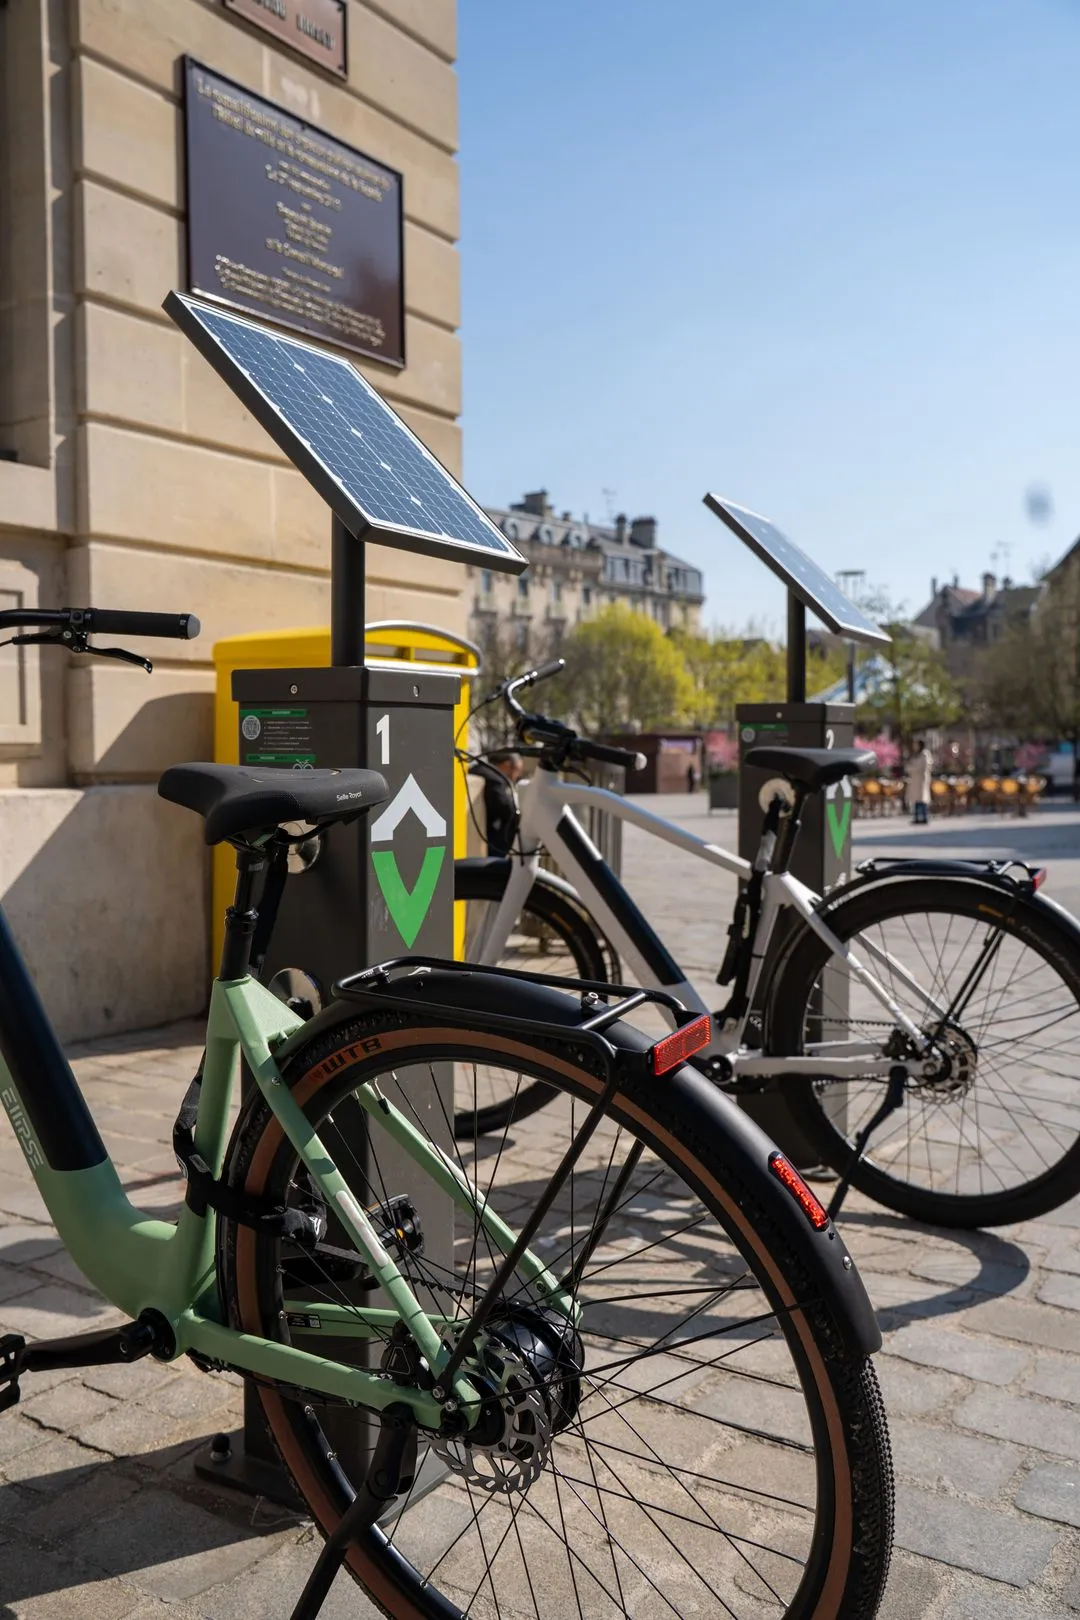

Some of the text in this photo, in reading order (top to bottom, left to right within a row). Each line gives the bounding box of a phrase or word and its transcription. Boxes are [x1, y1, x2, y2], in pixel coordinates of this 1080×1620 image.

[376, 714, 389, 765] 1
[336, 791, 362, 802] Selle Royal
